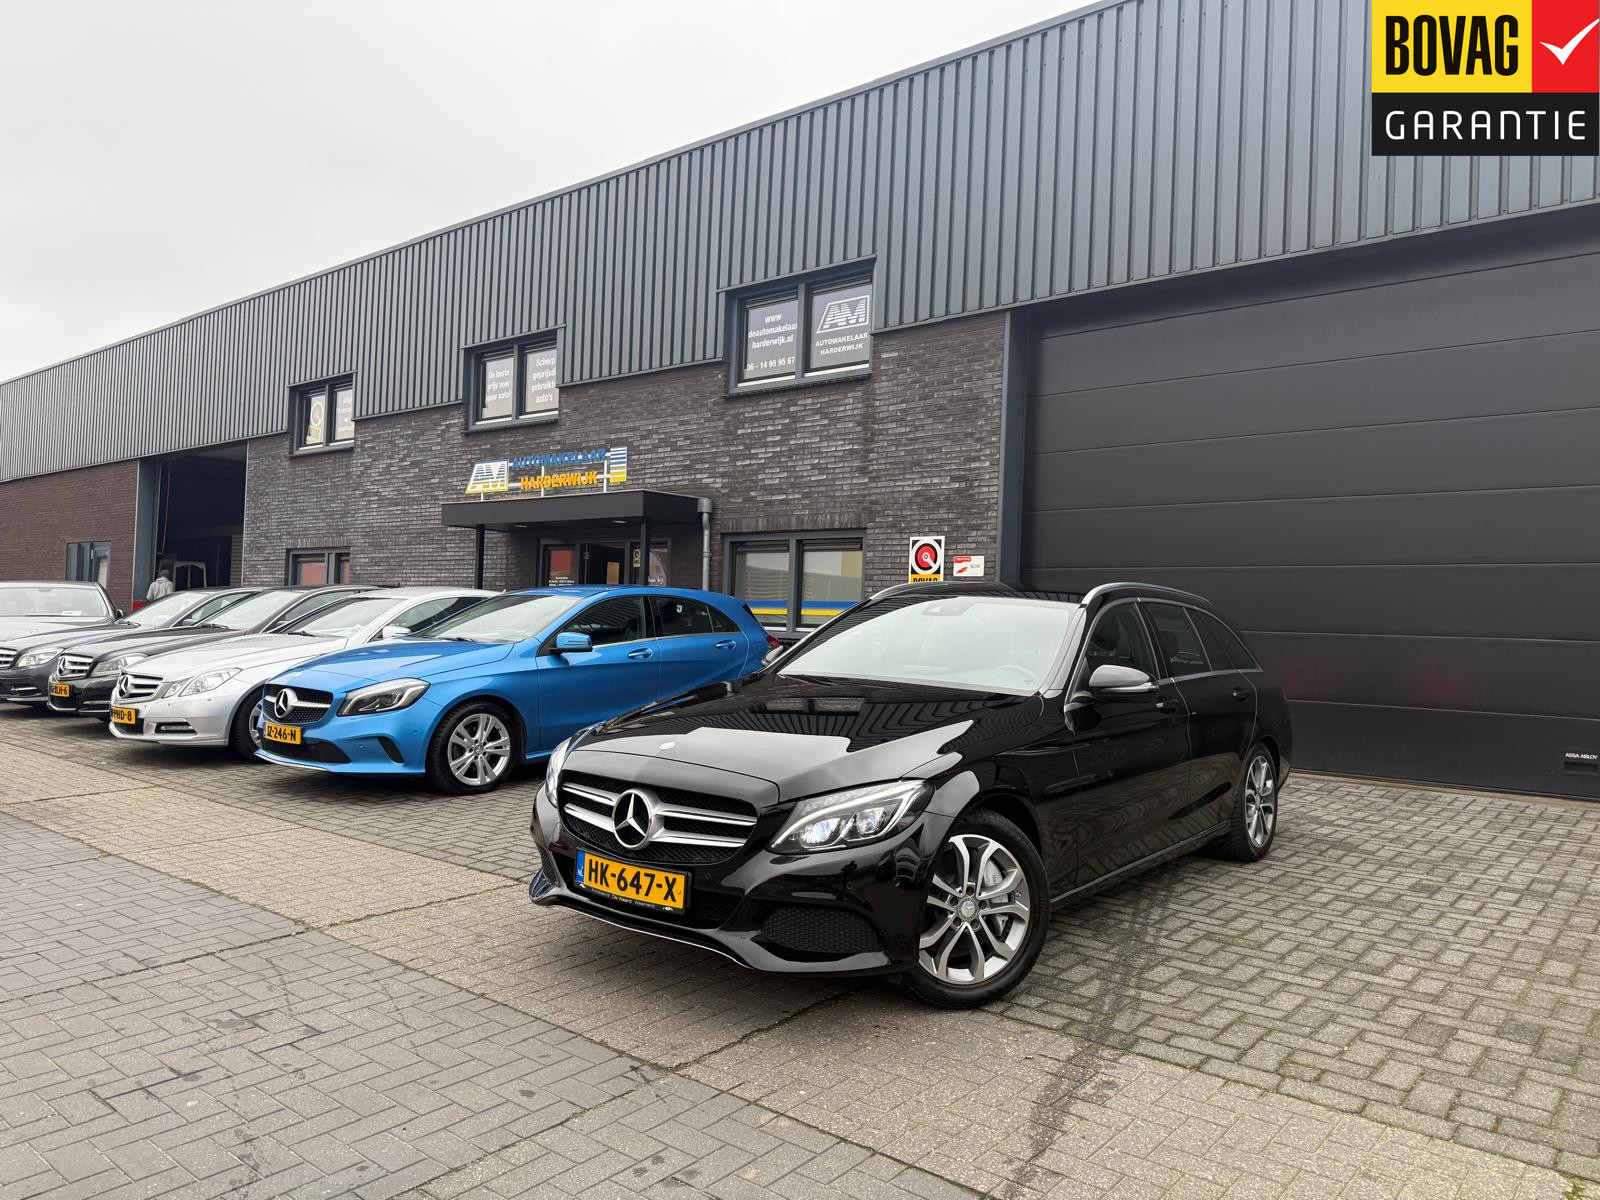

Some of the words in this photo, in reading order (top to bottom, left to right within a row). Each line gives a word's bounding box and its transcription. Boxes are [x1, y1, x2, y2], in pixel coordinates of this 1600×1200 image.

[764, 313, 782, 323] www
[751, 334, 794, 349] harderwijk.nl
[815, 333, 869, 347] AUTOMAKELAAR
[820, 342, 864, 355] HARDERWIJK
[746, 362, 754, 371] 06
[760, 361, 768, 369] 14
[511, 447, 606, 470] AUTOMAKELAAR
[520, 470, 598, 490] HARDERWIJK
[588, 858, 677, 903] HK-647-X
